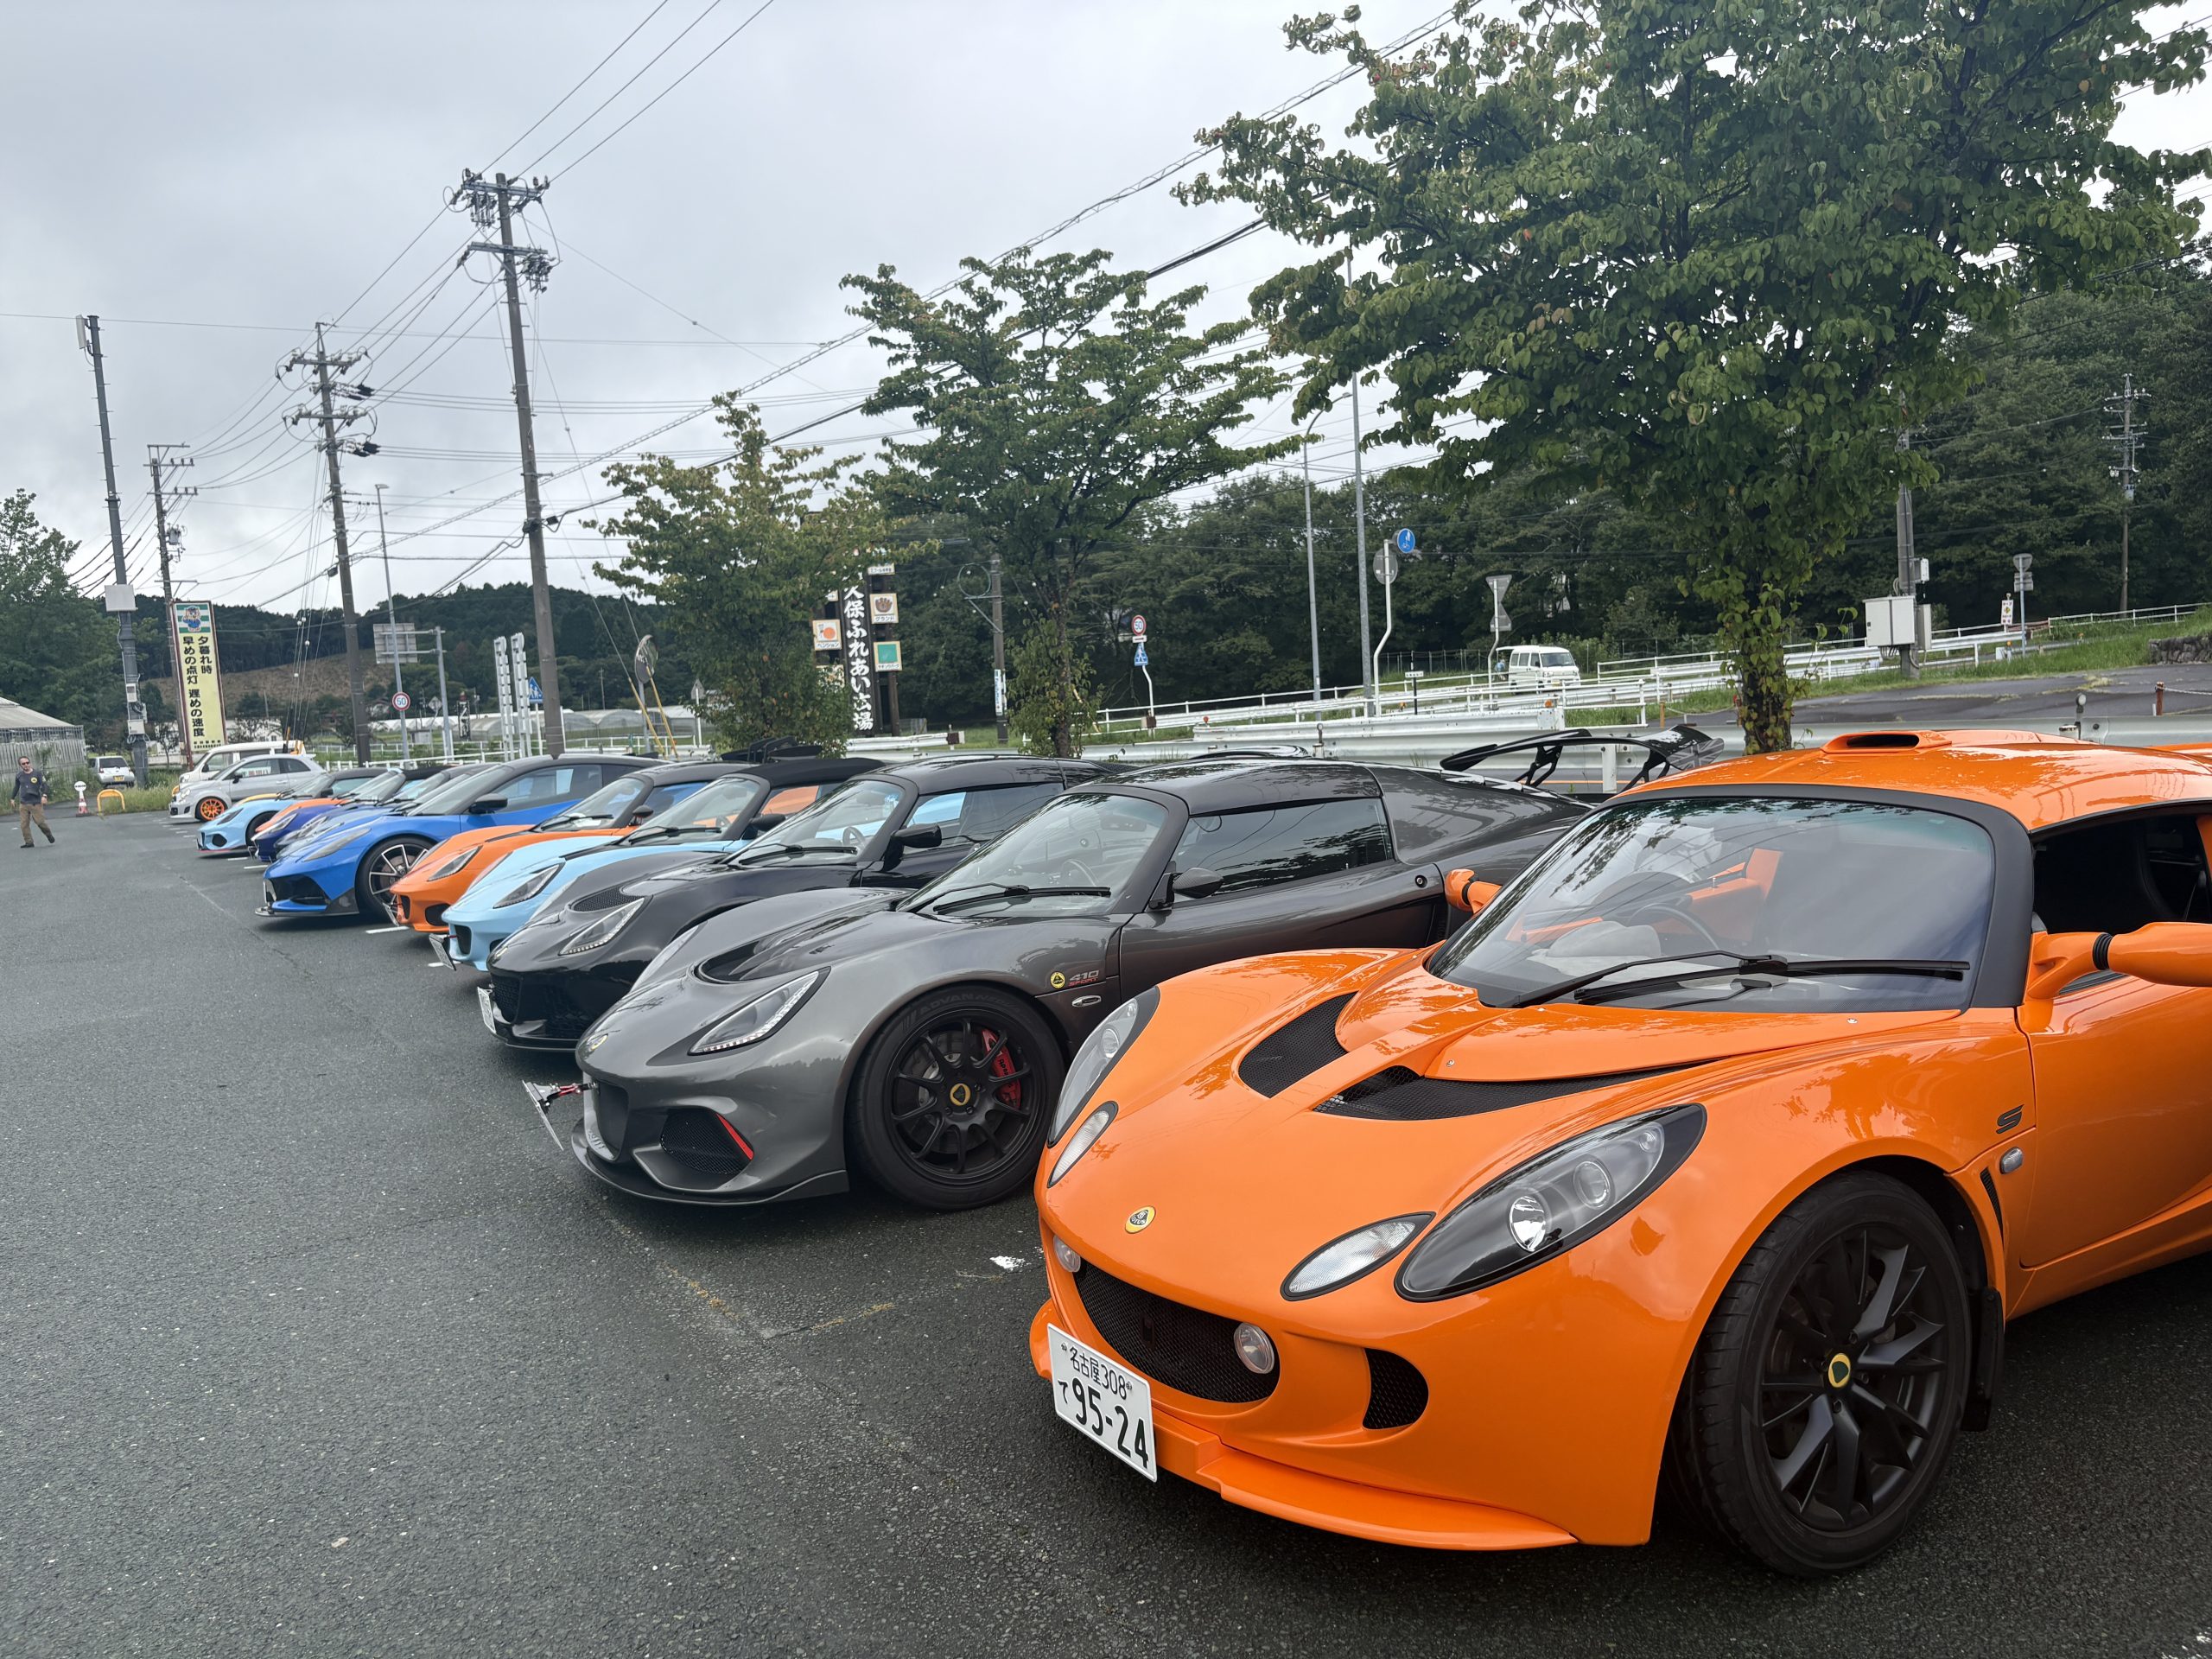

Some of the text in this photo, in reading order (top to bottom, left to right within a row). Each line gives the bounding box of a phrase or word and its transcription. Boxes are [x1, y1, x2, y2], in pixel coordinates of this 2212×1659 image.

[198, 635, 213, 674] 夕暮れ時
[842, 566, 874, 731] 久保ふれあい広場
[182, 636, 205, 737] 早めの点灯 遅めの速度
[397, 697, 406, 706] 50
[1068, 977, 1098, 987] SPORT
[1070, 969, 1100, 982] 410
[919, 994, 974, 1015] ADVAN
[1058, 1377, 1149, 1469] て 95-24
